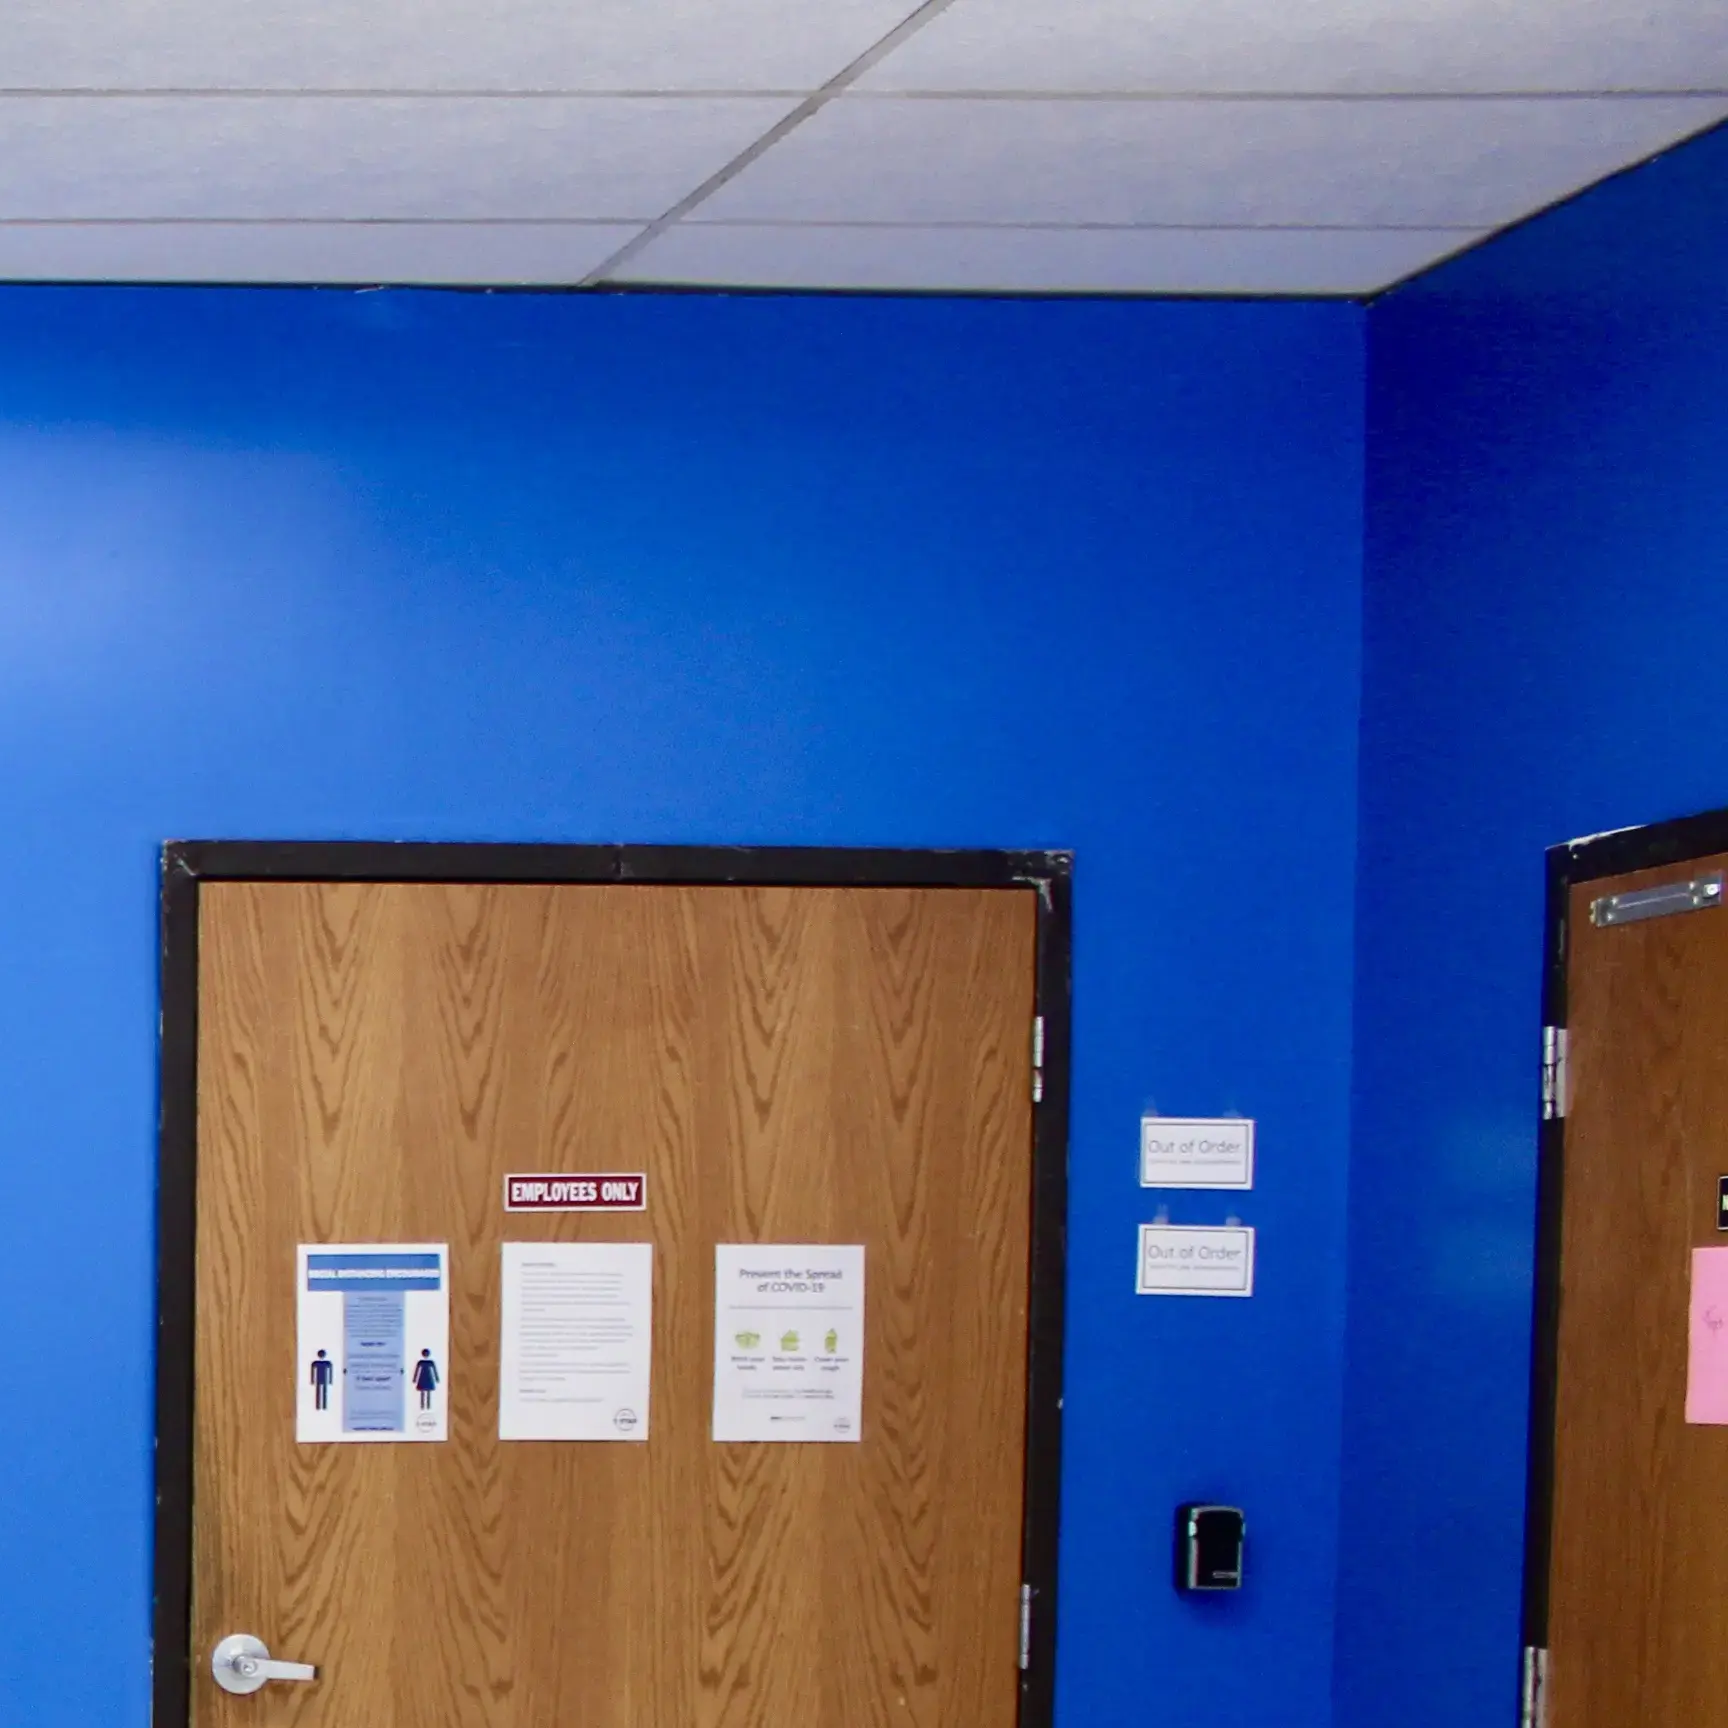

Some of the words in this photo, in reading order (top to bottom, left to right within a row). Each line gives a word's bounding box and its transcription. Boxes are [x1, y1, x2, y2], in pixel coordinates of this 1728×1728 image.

[1148, 1139, 1175, 1154] Out
[1180, 1139, 1195, 1154] of
[1198, 1139, 1242, 1154] Order
[511, 1181, 598, 1202] EMPLOYEES
[601, 1181, 640, 1202] ONLY
[1148, 1245, 1175, 1260] Out
[1179, 1245, 1195, 1260] of
[1198, 1245, 1242, 1260] Order
[784, 1268, 803, 1279] the
[806, 1268, 843, 1280] Spread
[757, 1282, 769, 1292] of
[771, 1282, 826, 1293] COVID-19
